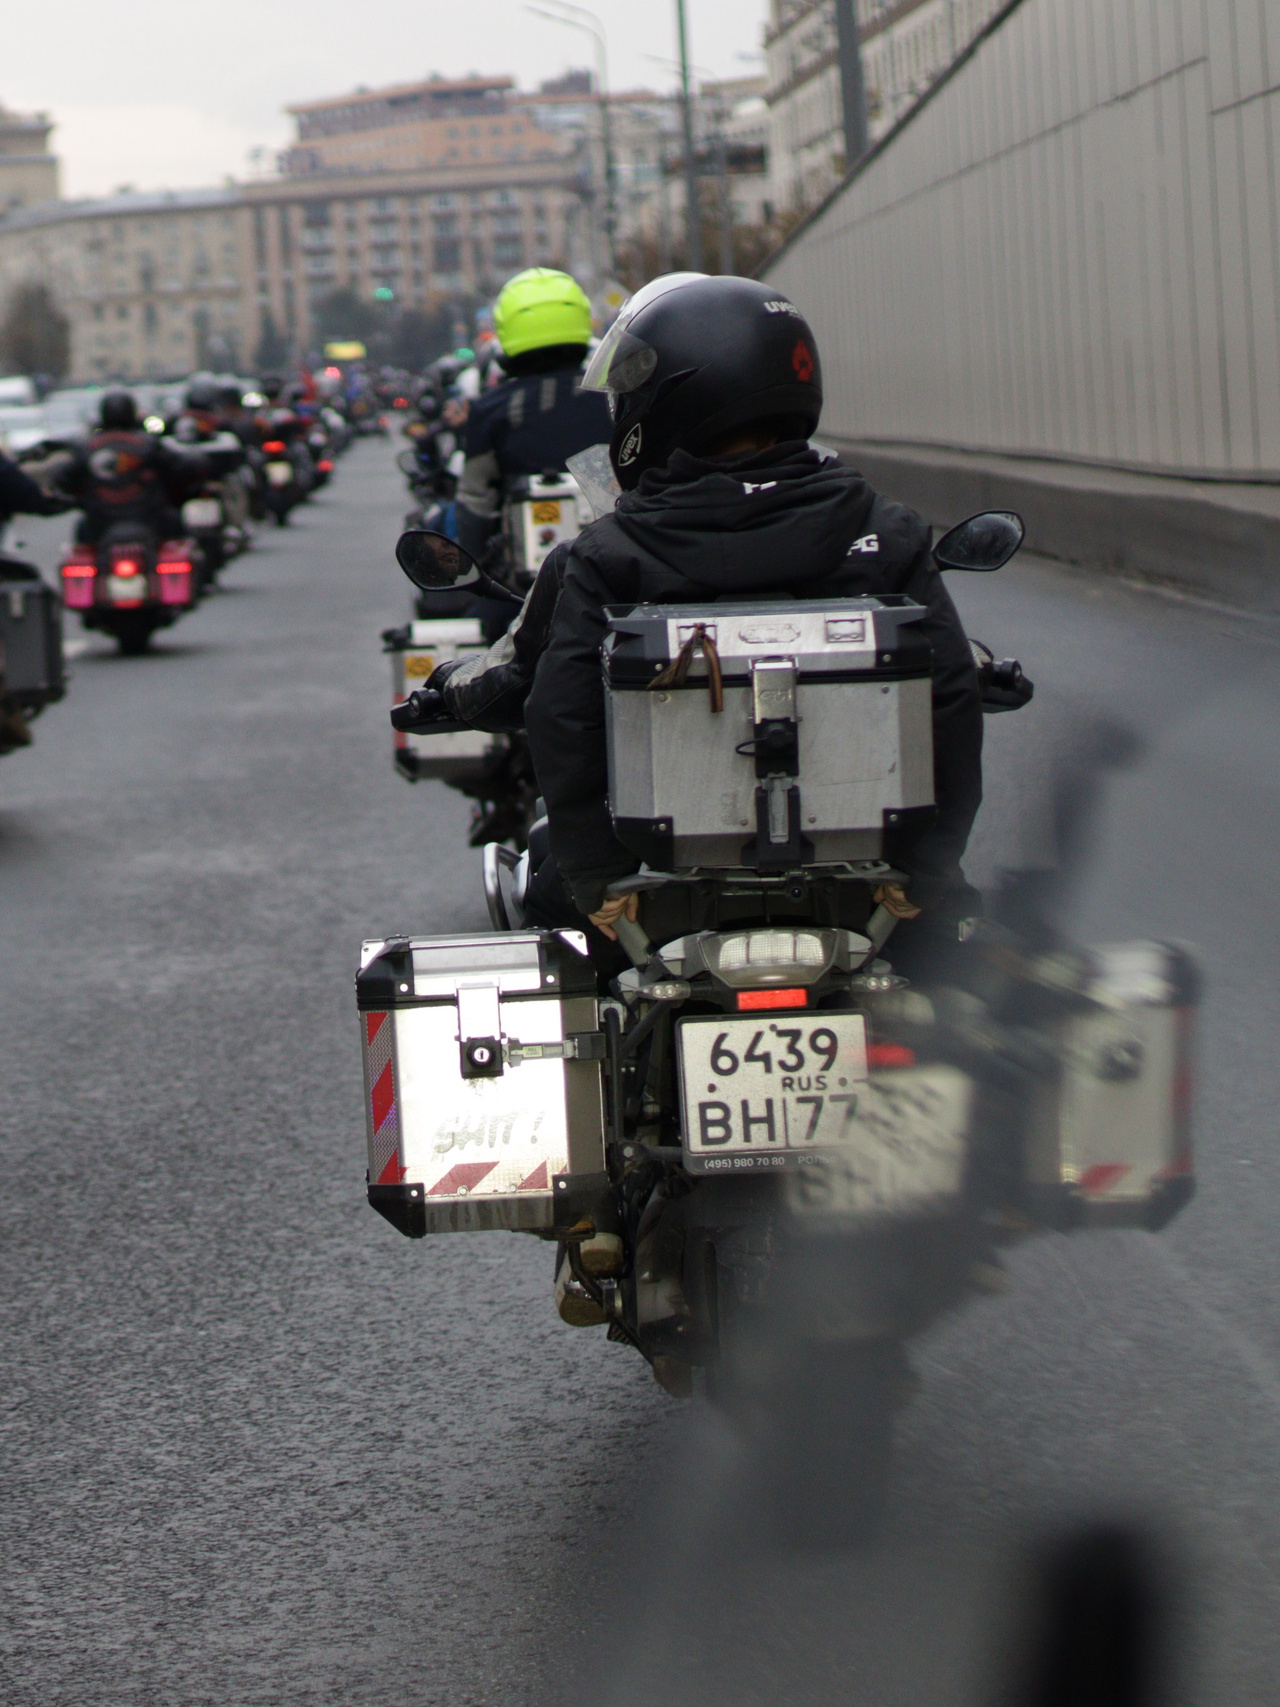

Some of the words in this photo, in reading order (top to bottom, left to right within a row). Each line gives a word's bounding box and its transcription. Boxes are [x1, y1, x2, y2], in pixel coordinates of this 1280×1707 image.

[621, 433, 639, 461] uvex
[710, 1028, 839, 1077] 6439
[782, 1075, 828, 1093] RUS
[796, 1093, 858, 1141] 77
[704, 1159, 732, 1170] (495)
[734, 1158, 754, 1168] 980
[756, 1157, 769, 1167] 70
[772, 1157, 785, 1166] 80
